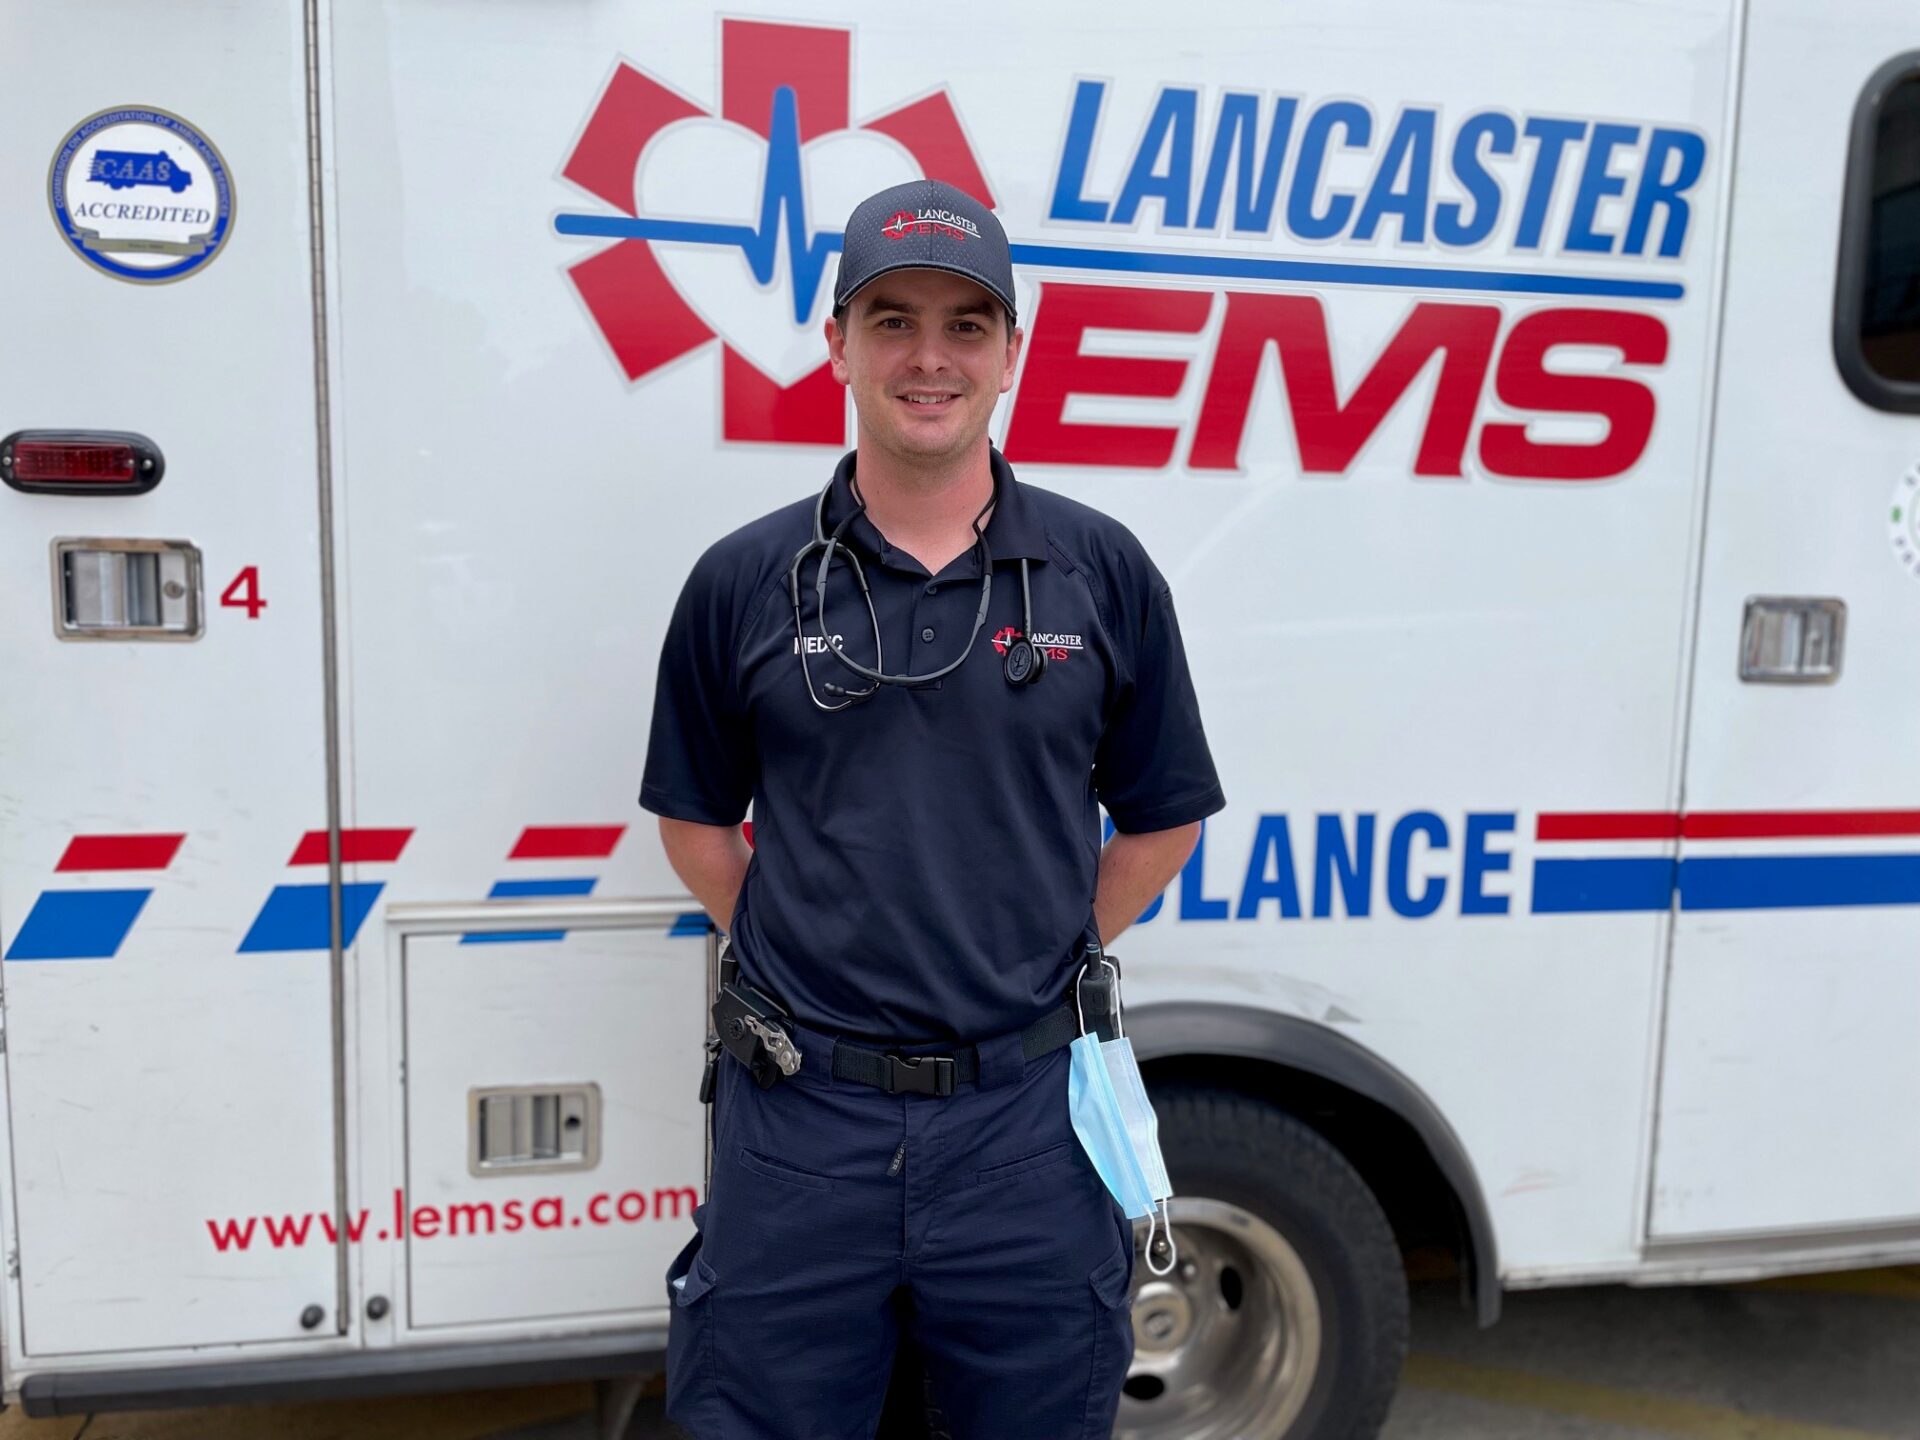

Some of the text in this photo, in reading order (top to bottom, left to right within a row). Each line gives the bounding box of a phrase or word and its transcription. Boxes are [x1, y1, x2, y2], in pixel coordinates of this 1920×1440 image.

[98, 157, 171, 182] CAAS
[1049, 80, 1706, 258] LANCASTER
[74, 202, 211, 225] ACCREDITED
[917, 209, 978, 234] LANCASTER
[917, 223, 965, 241] EMS
[1003, 282, 1669, 480] EMS
[221, 566, 267, 619] 4
[794, 634, 843, 655] MEDC
[1031, 632, 1082, 645] ANCASTER
[1104, 811, 1516, 925] LANCE
[206, 1186, 699, 1252] www.lemsa.com
